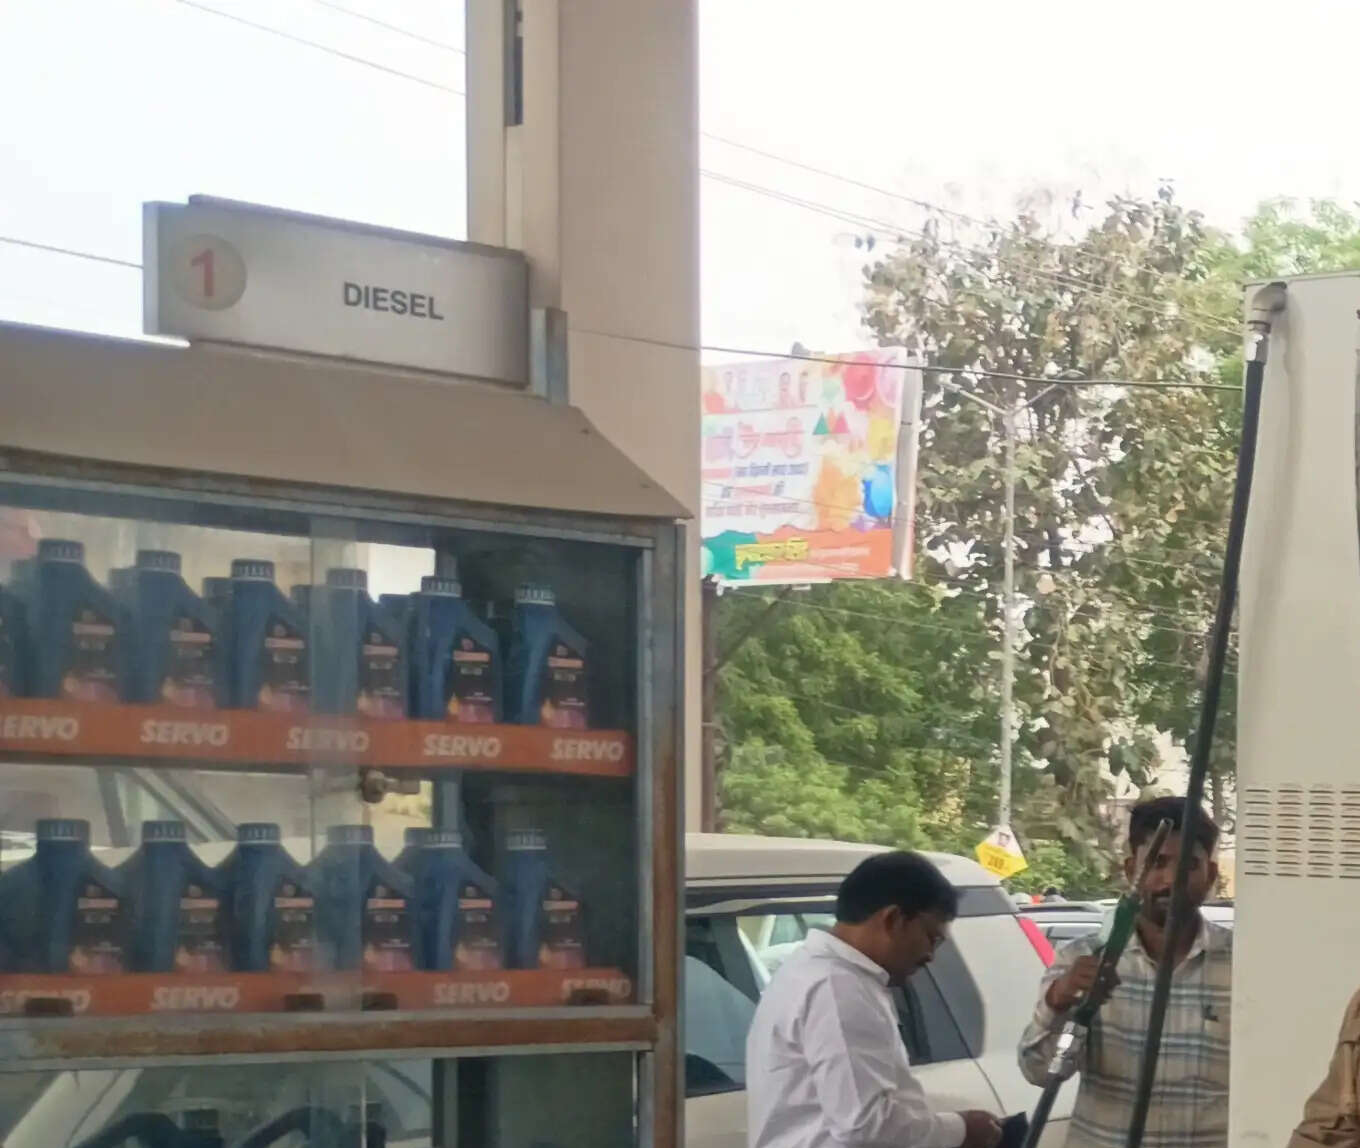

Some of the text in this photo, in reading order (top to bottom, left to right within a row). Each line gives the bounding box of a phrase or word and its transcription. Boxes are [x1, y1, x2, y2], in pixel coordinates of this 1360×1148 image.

[191, 248, 214, 297] 1
[342, 281, 445, 321] DIESEL
[0, 713, 625, 762] ERVO SERVO SERVO SERVO SERVO
[153, 986, 240, 1009] SERVO
[433, 981, 510, 1003] SERVO
